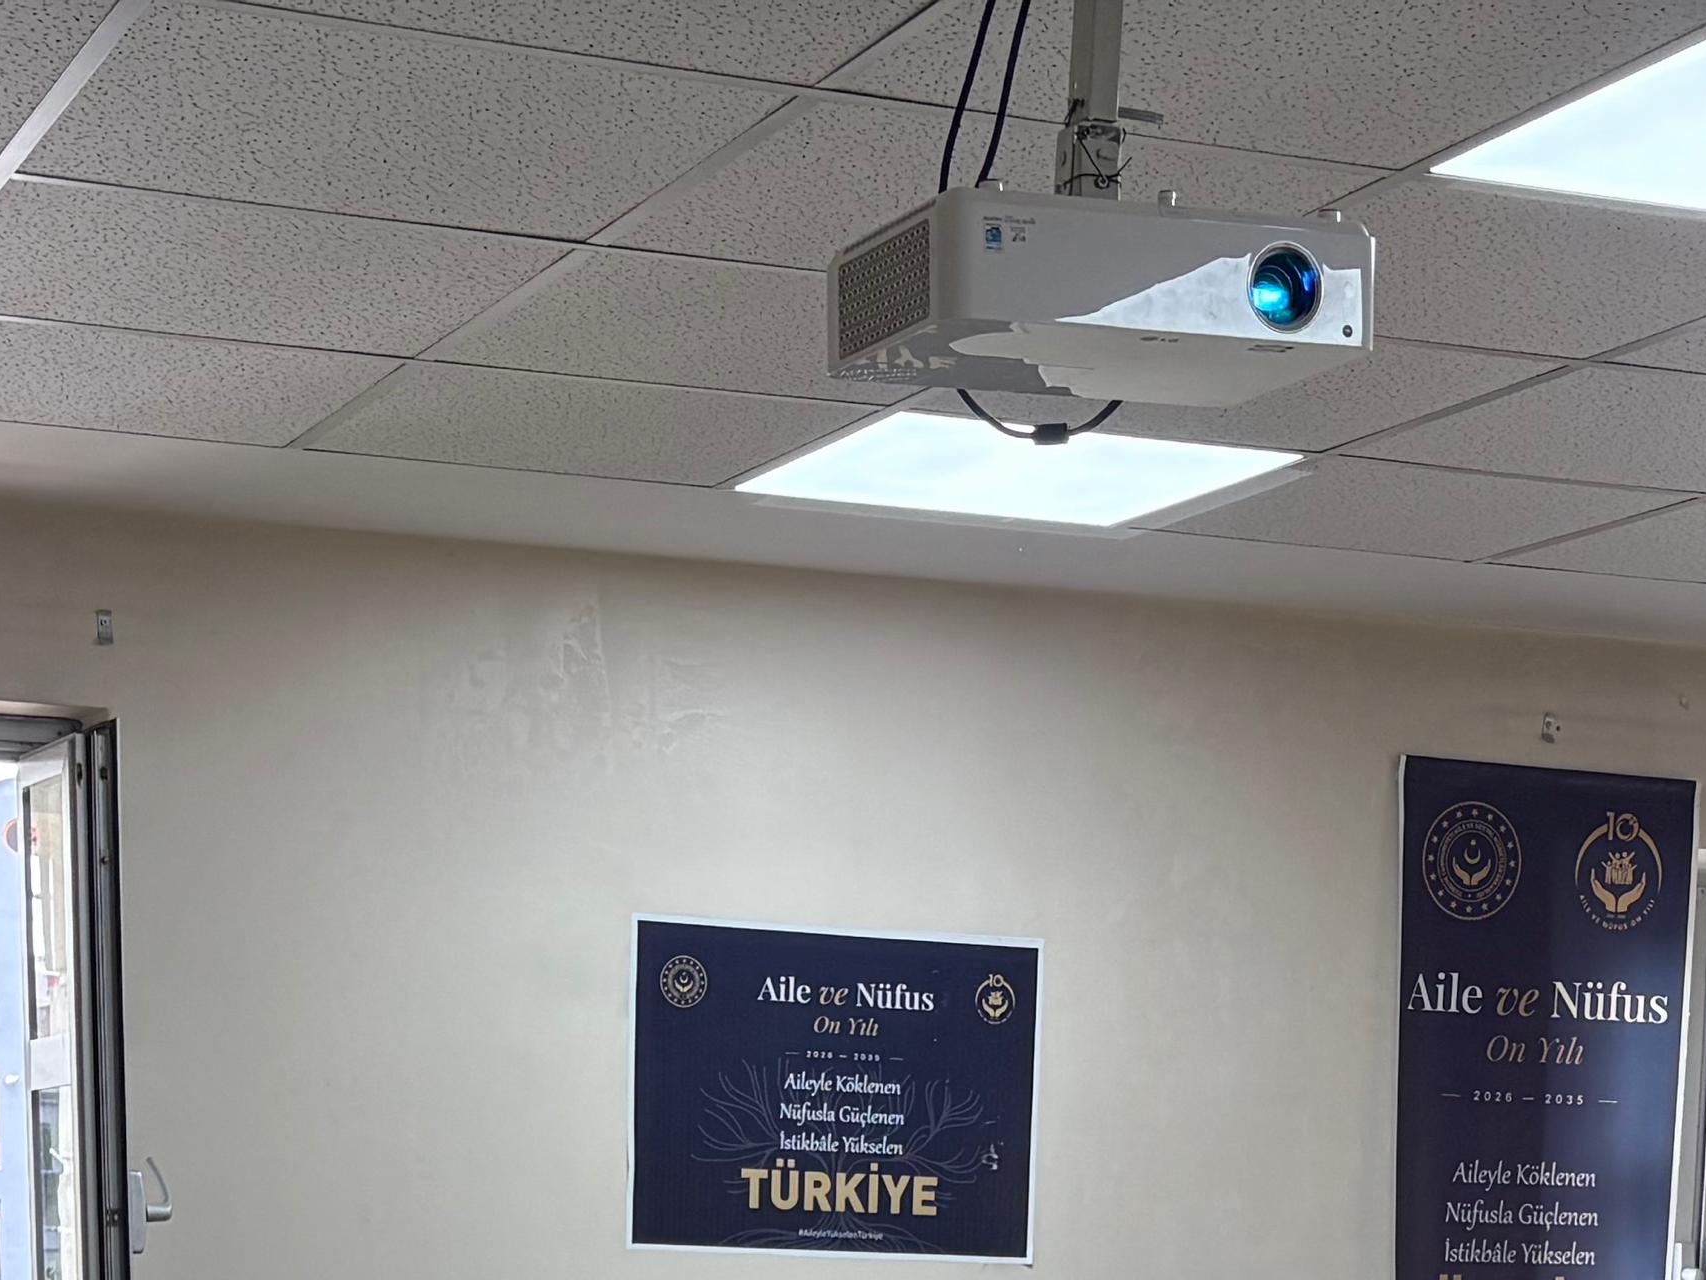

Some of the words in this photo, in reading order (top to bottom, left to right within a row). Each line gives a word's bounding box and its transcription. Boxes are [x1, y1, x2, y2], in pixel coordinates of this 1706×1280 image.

[757, 976, 811, 1004] Aile
[818, 987, 848, 1006] ve
[855, 982, 935, 1012] Nüfus
[1406, 972, 1483, 1014] Aile
[1496, 987, 1540, 1017] ve
[1550, 981, 1669, 1024] Nüfus
[813, 1016, 842, 1036] On
[848, 1016, 879, 1037] Yılı
[1486, 1035, 1526, 1063] On
[1538, 1036, 1585, 1065] Yılı
[784, 1071, 832, 1097] Aileyle
[836, 1074, 902, 1096] Köklenen
[1473, 1090, 1513, 1102] 2026
[1544, 1093, 1584, 1105] 2035
[780, 1102, 836, 1126] Nüfusla
[839, 1105, 905, 1128] Güçlenen
[780, 1131, 839, 1152] İstikbâle
[843, 1135, 903, 1155] Yükselen
[740, 1158, 939, 1216] TÜRKİYE
[1452, 1160, 1511, 1192] Aileyle
[1516, 1161, 1597, 1188] Köklenen
[1445, 1200, 1513, 1231] Nüfusla
[1518, 1202, 1599, 1232] Güçlenen
[1444, 1237, 1516, 1265] İstikbâle
[1521, 1239, 1596, 1266] Yükselen
